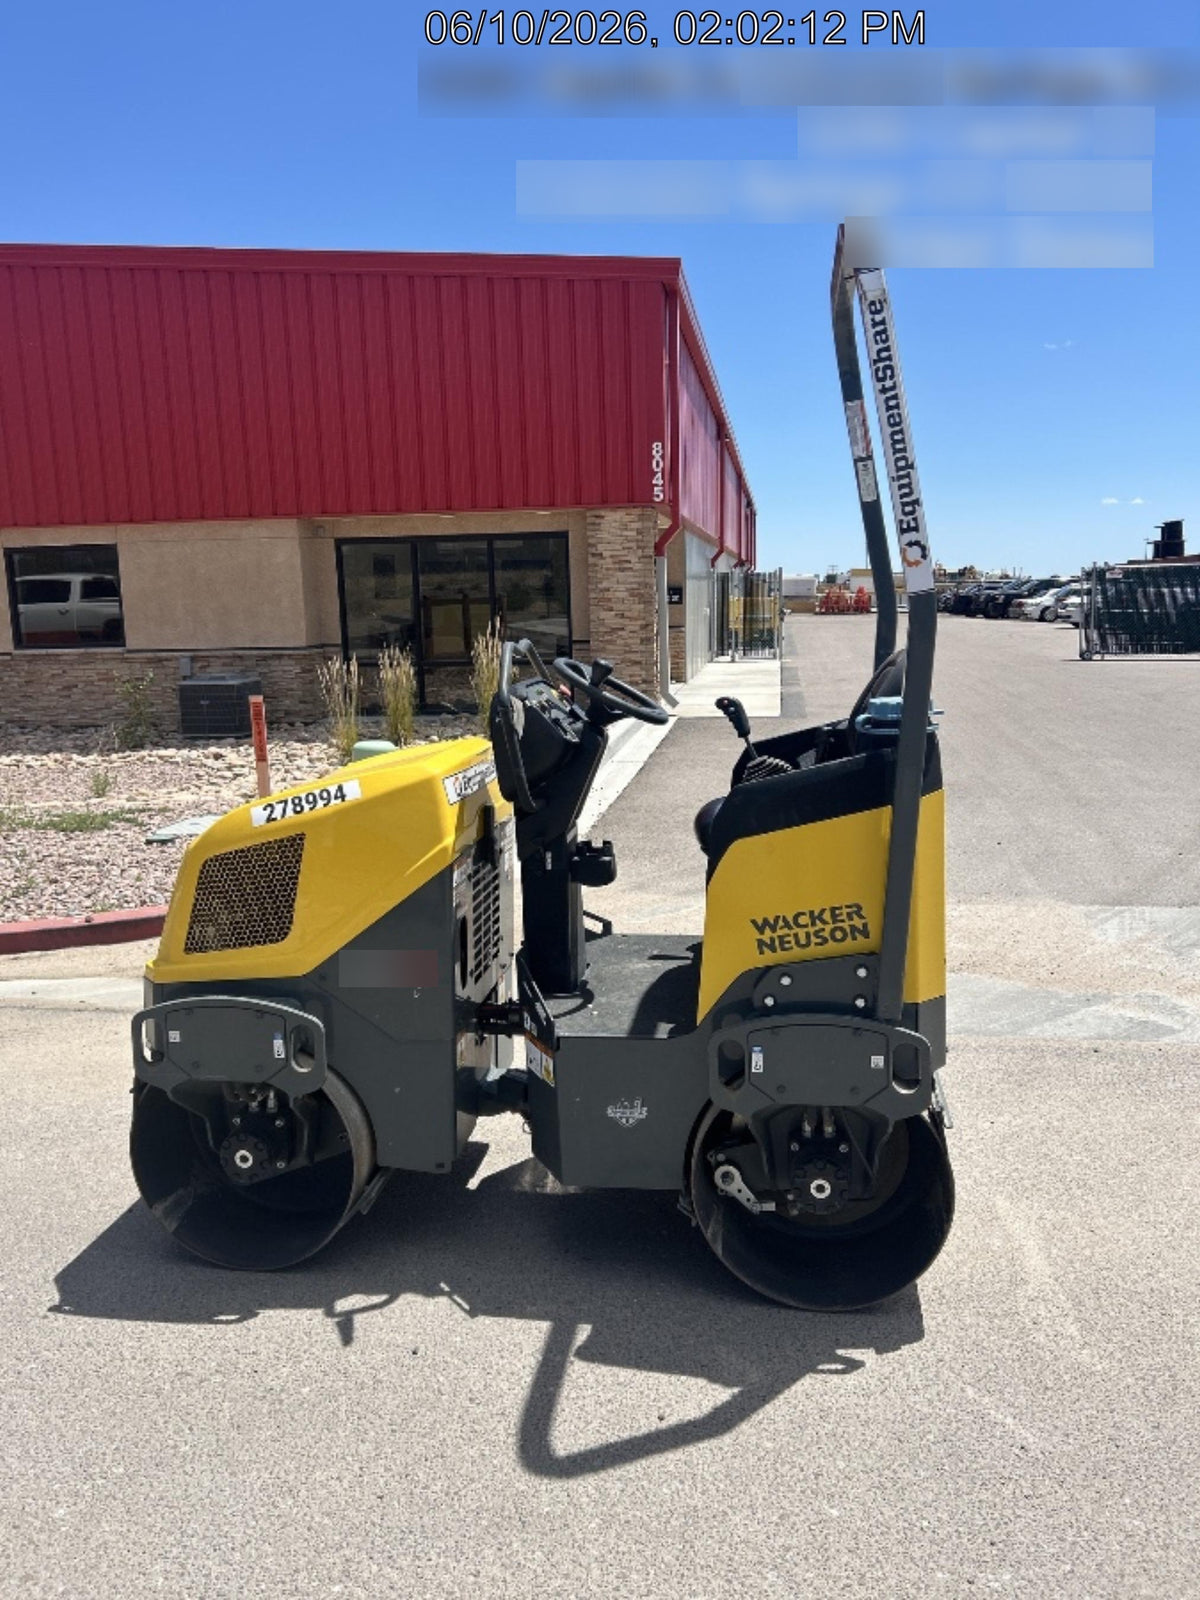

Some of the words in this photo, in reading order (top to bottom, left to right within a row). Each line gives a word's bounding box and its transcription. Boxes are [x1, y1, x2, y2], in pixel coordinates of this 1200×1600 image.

[867, 298, 919, 536] EquipmentShare
[651, 441, 664, 502] 8045
[262, 784, 347, 824] 278994
[750, 902, 867, 935] WACKER
[755, 922, 871, 955] NEUSON
